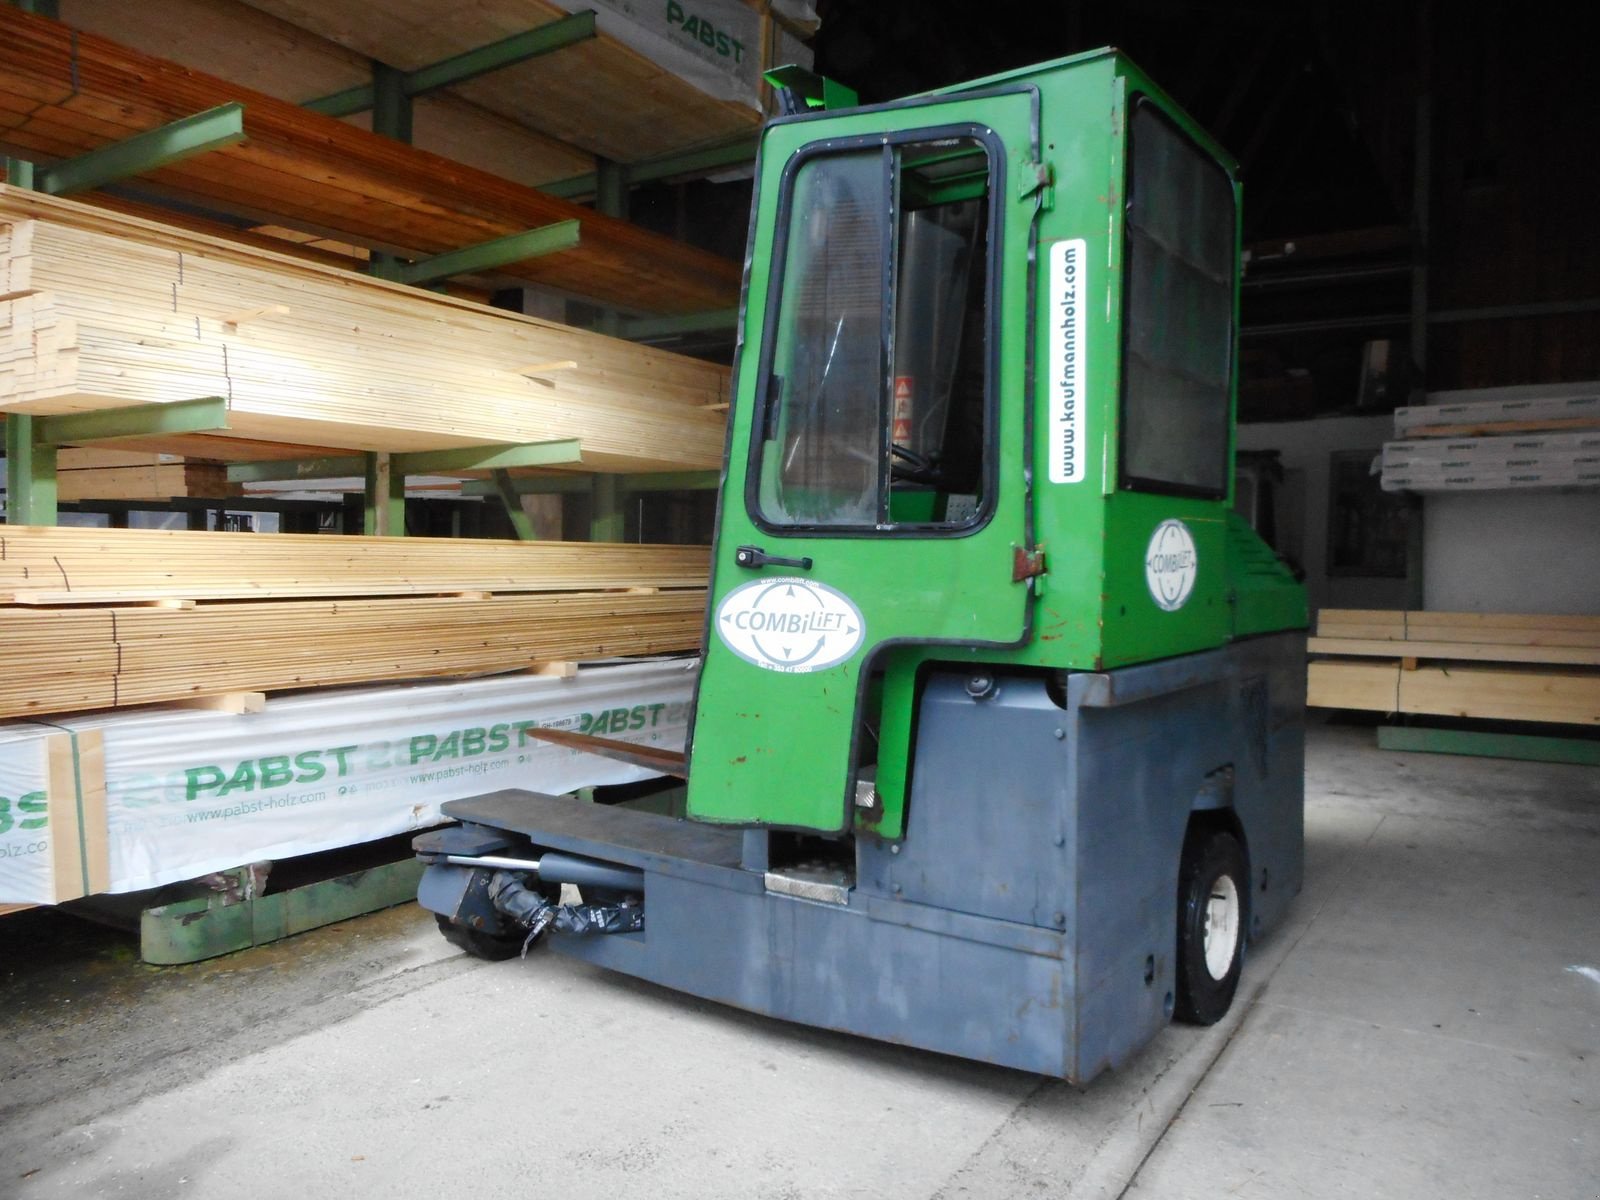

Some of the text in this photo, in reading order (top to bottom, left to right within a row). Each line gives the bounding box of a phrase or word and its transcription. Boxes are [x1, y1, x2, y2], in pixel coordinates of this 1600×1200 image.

[667, 0, 745, 64] PABST
[1059, 247, 1076, 477] www.kaufmannholz.com
[184, 744, 358, 801] PABST
[409, 720, 535, 765] PABST
[410, 758, 510, 785] www.pabst-holz.com
[187, 791, 326, 824] www.pabst-holz.com
